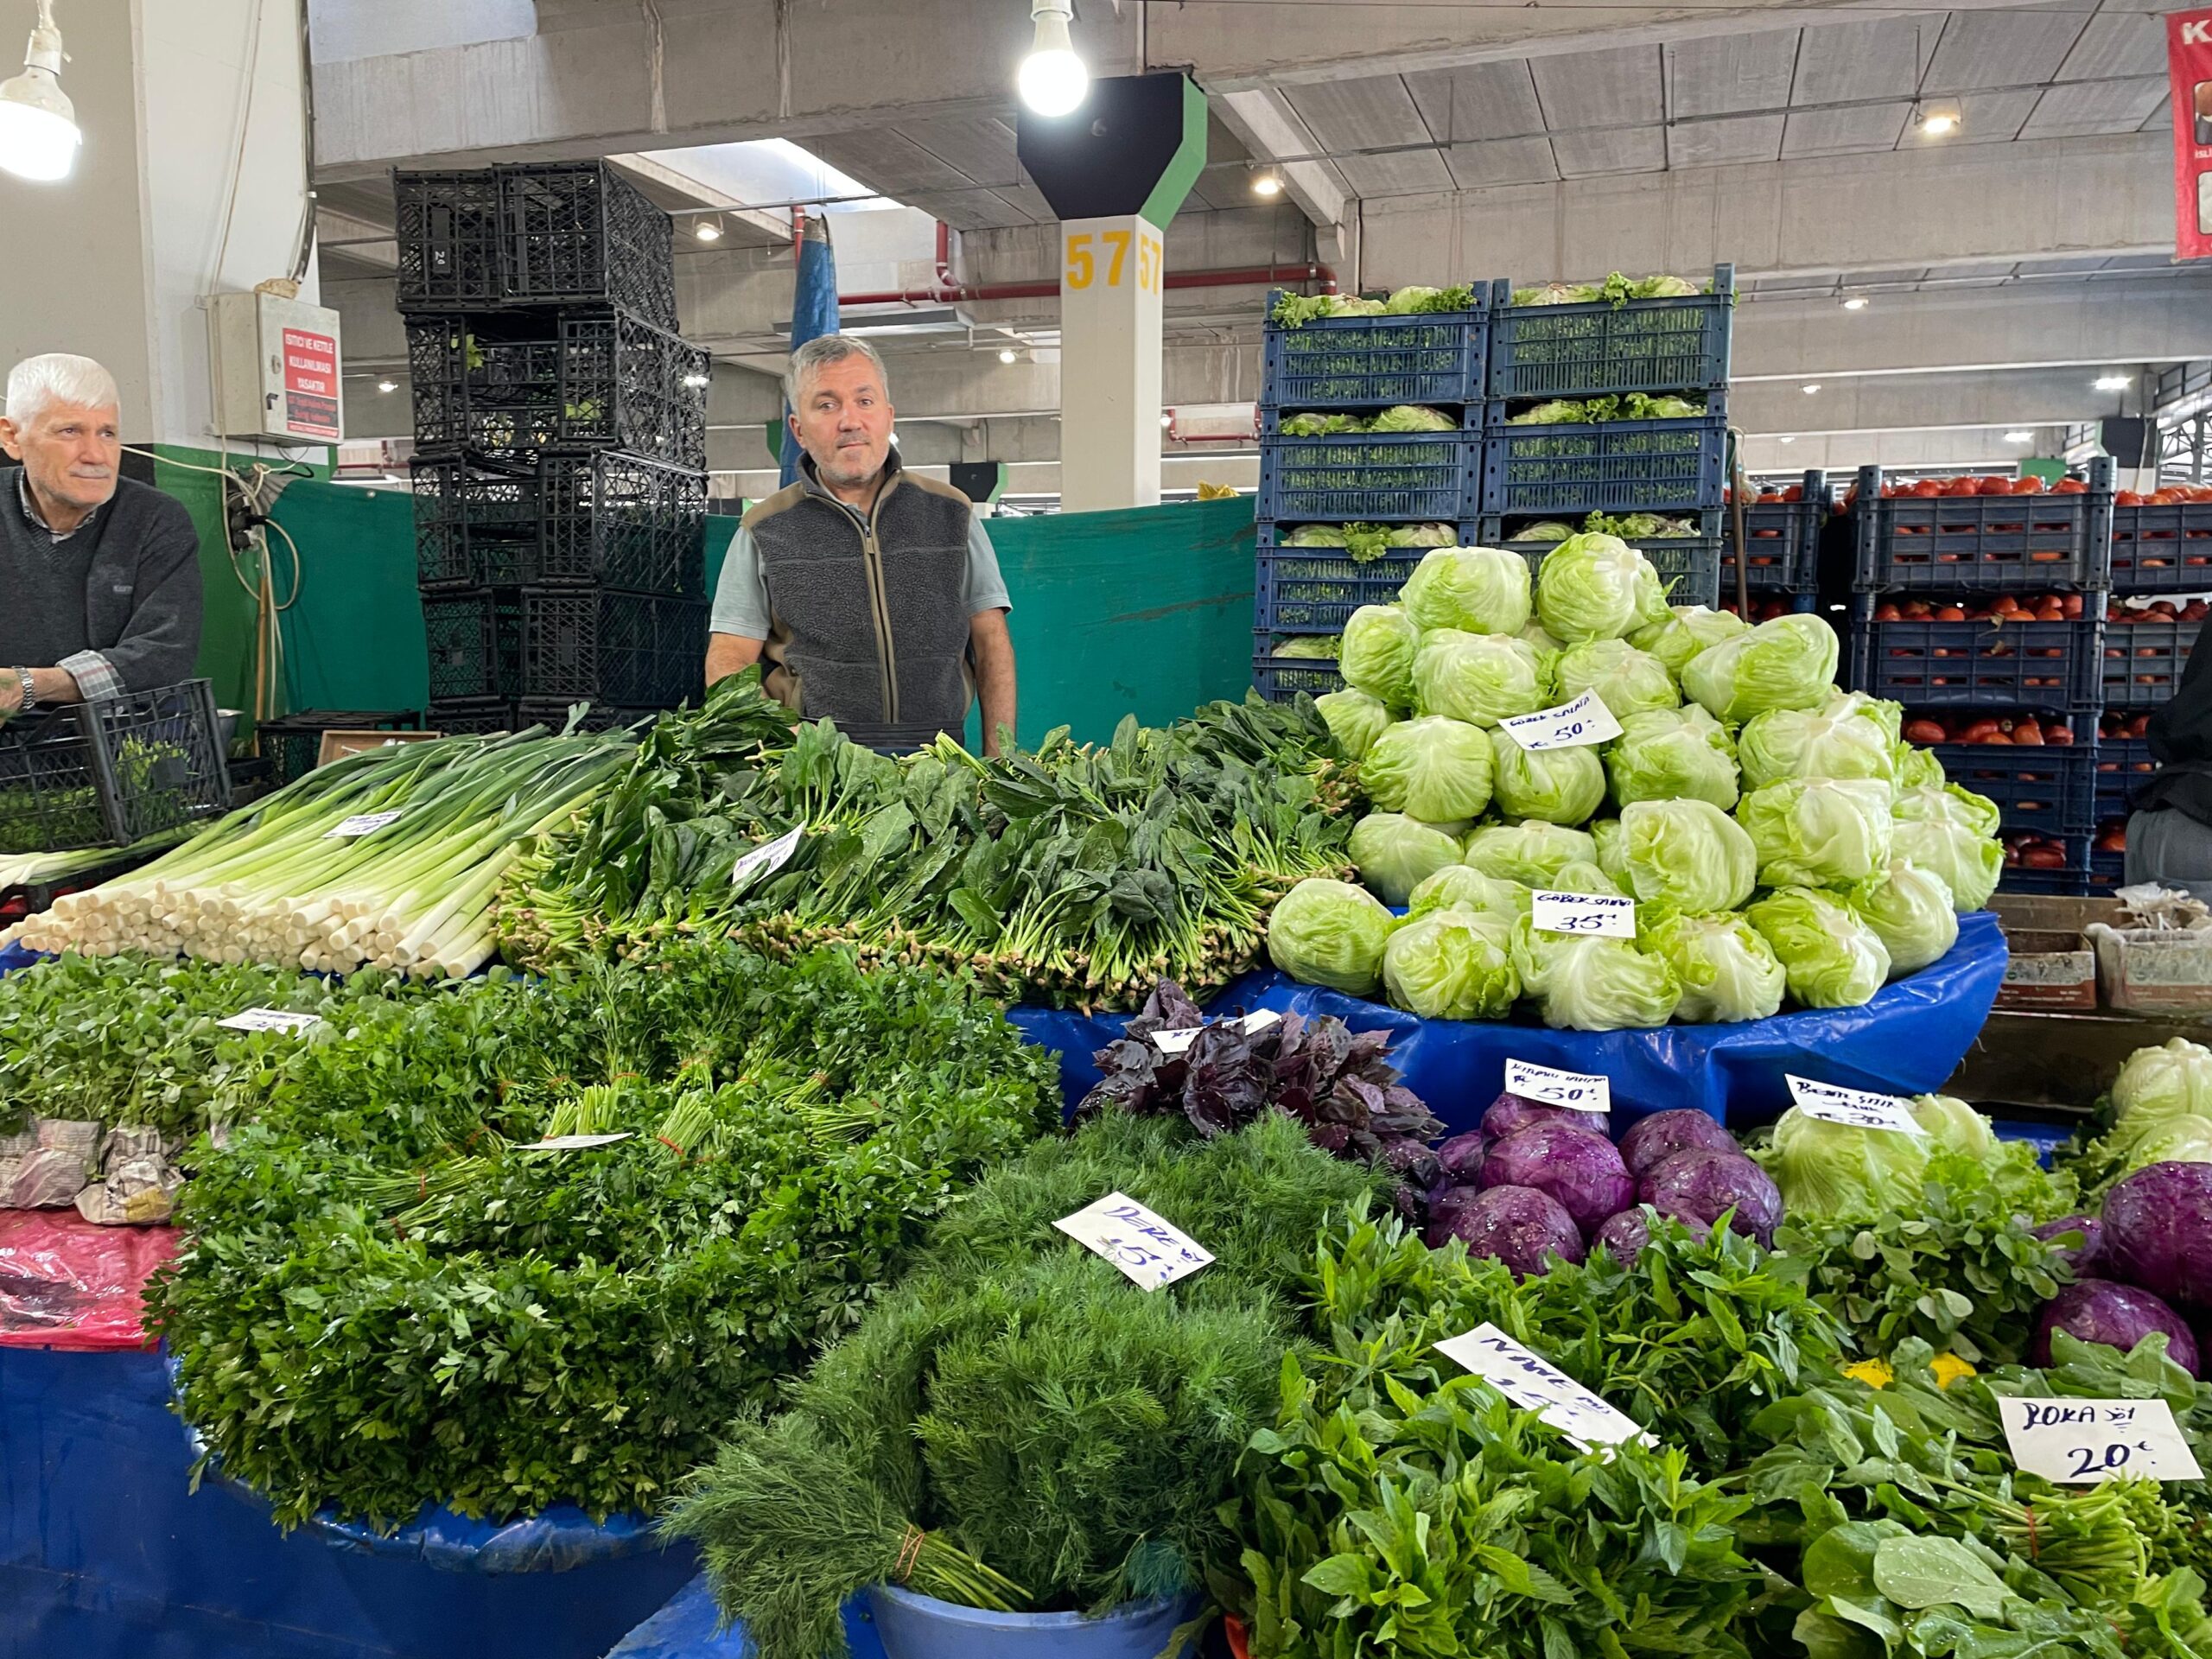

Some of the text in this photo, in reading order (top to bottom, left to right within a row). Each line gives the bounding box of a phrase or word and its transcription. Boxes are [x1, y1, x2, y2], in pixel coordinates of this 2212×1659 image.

[2182, 18, 2212, 46] K
[1066, 230, 1132, 290] 57
[1140, 233, 1162, 295] 57
[2022, 1402, 2095, 1431] ROKA
